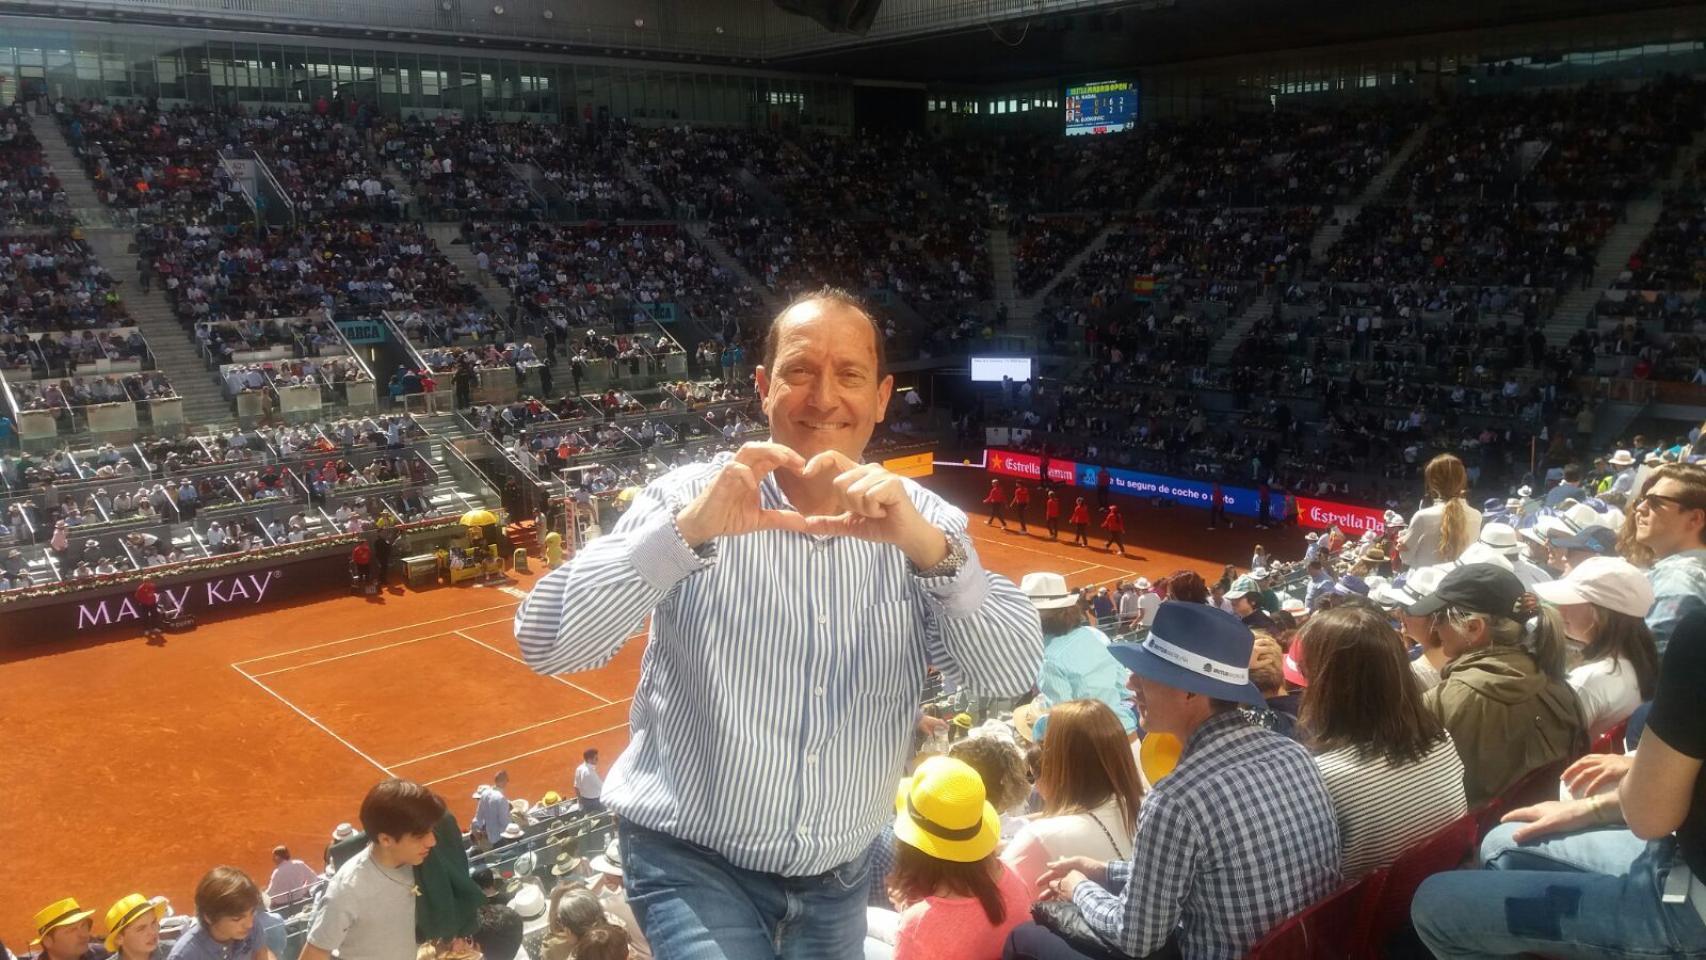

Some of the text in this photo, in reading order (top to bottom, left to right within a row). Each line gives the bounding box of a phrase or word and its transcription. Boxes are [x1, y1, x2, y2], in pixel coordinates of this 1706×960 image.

[1005, 457, 1073, 480] Estrella amm
[1116, 477, 1125, 487] tu
[1127, 480, 1157, 494] seguro
[1158, 484, 1170, 494] de
[1171, 486, 1200, 499] coche
[1201, 493, 1208, 501] o
[1310, 505, 1385, 533] Estrella Da
[77, 571, 273, 629] MAY KAY
